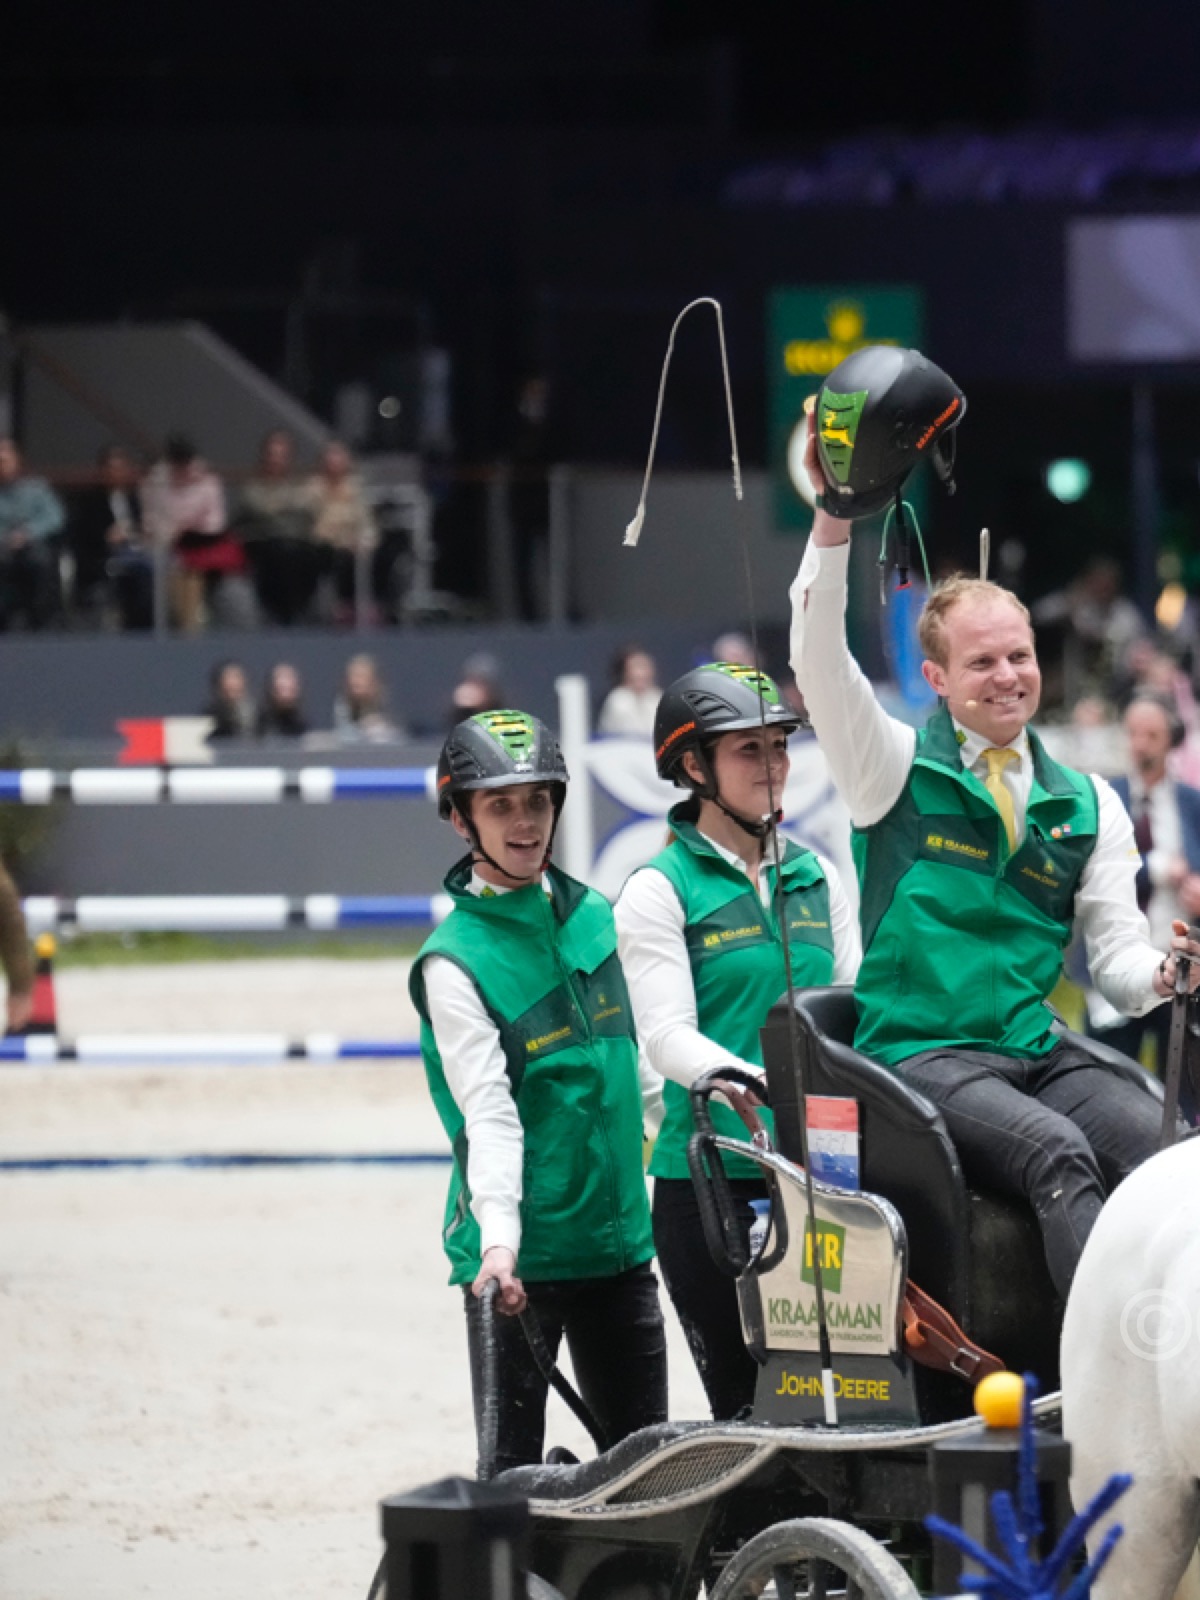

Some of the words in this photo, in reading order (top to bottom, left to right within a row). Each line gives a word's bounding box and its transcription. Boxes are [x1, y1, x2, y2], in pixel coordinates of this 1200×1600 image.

[805, 1232, 842, 1270] KR
[768, 1298, 883, 1330] KRAAKMAN
[776, 1370, 825, 1397] JOHN
[829, 1373, 890, 1401] DEERE
